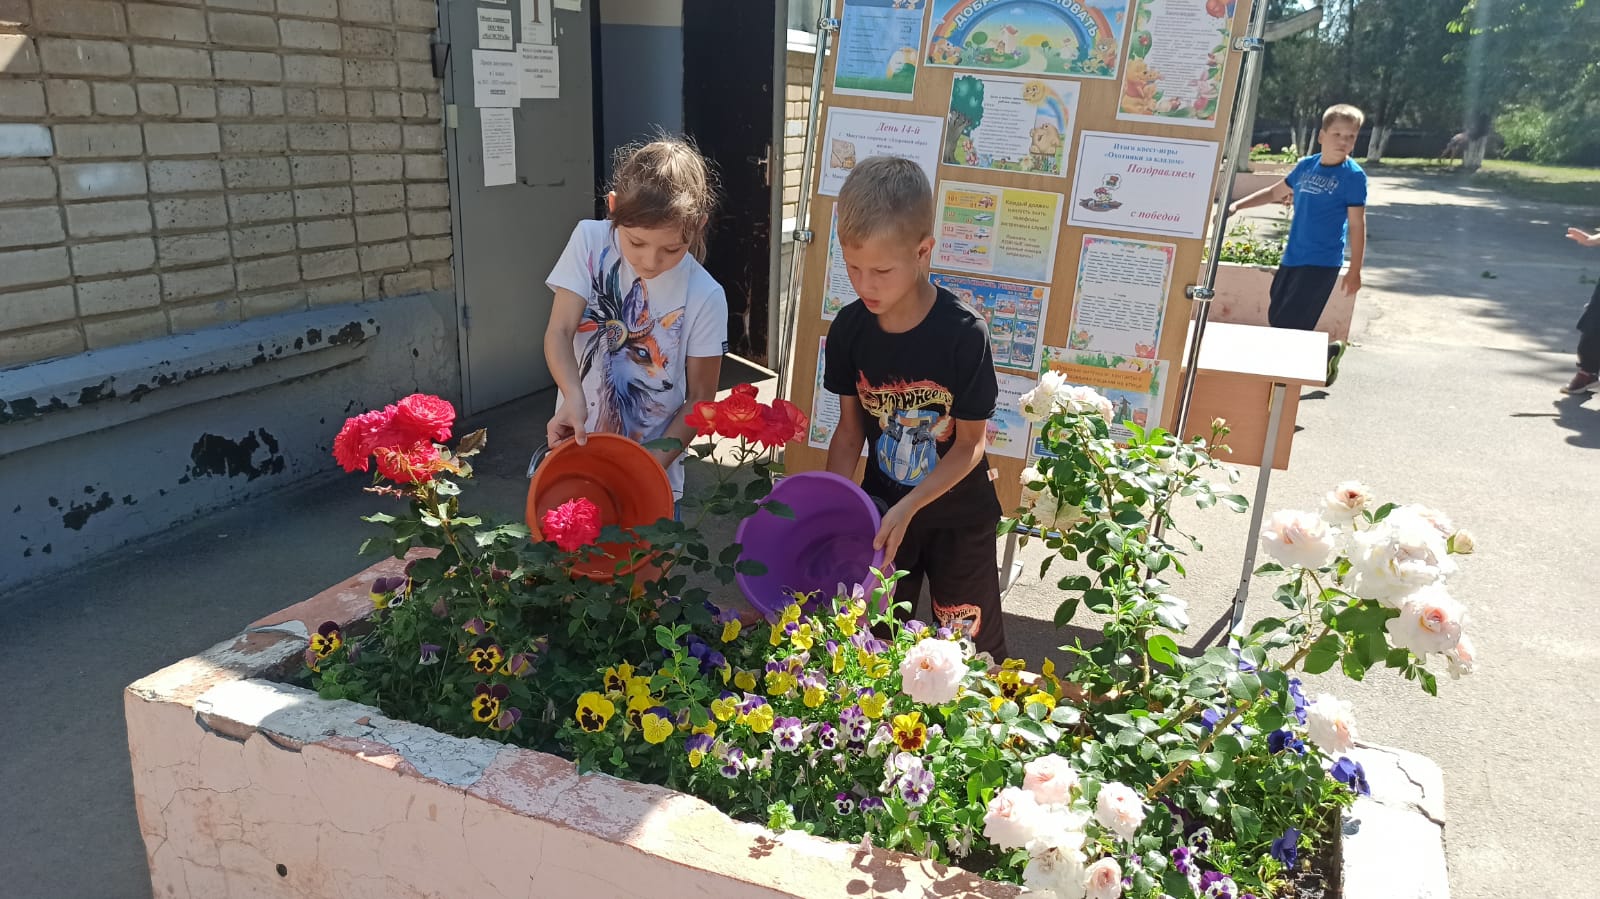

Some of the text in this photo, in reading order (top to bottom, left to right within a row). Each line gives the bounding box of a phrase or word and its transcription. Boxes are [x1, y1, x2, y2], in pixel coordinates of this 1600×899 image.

[876, 122, 899, 133] День
[1113, 143, 1179, 156] Итоги квест-игры
[1104, 151, 1144, 161] «Охотники
[1127, 163, 1196, 180] Поздравляем
[1130, 210, 1181, 222] с победой
